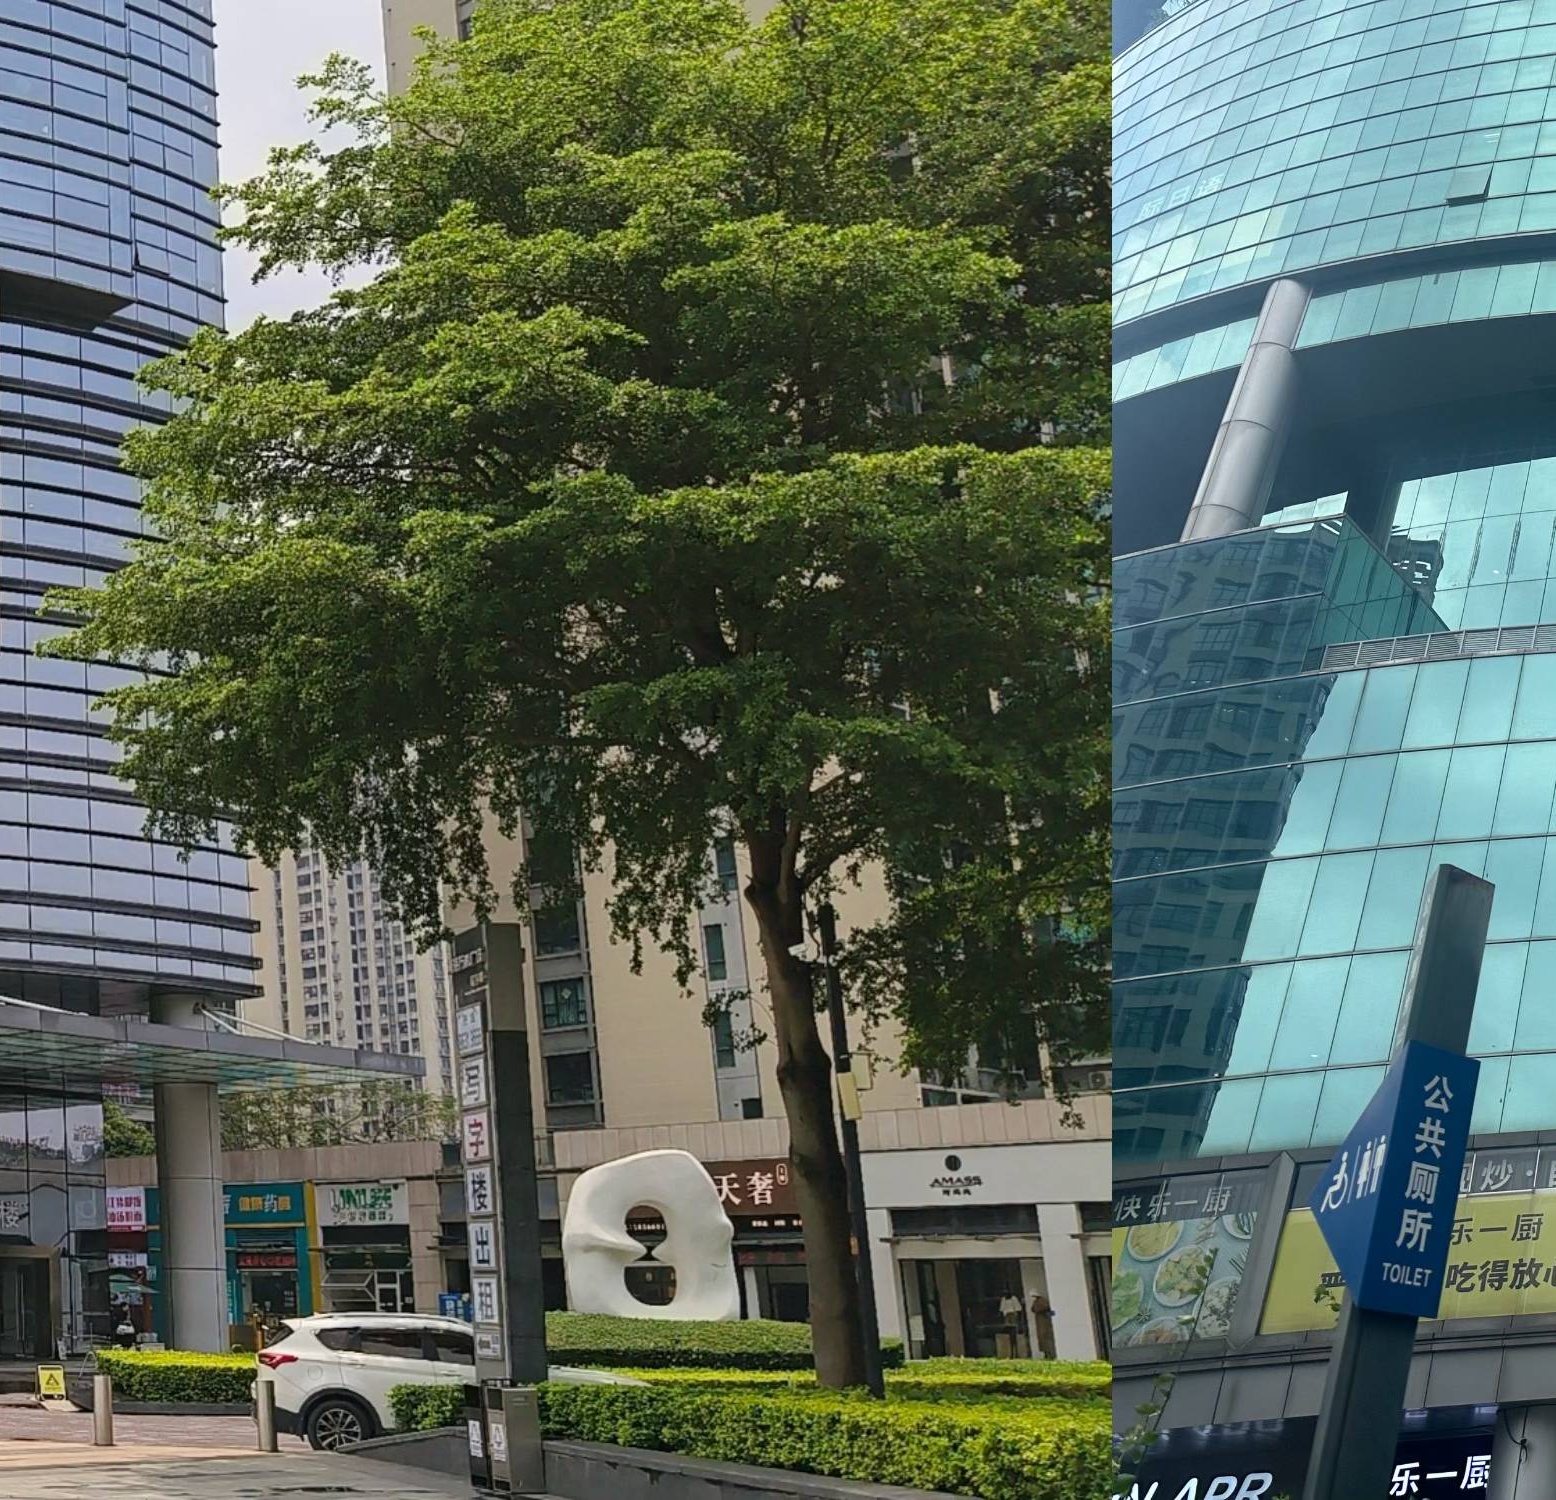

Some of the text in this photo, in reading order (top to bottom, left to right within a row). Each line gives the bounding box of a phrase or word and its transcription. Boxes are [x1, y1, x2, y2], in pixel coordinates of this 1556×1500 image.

[1396, 1075, 1454, 1252] 公共厕所
[463, 1064, 495, 1322] 写字楼出租
[713, 1171, 774, 1205] 天奢
[929, 1175, 983, 1188] AMASS
[1113, 1184, 1231, 1221] 快乐一厨
[1381, 1263, 1433, 1288] TOILET
